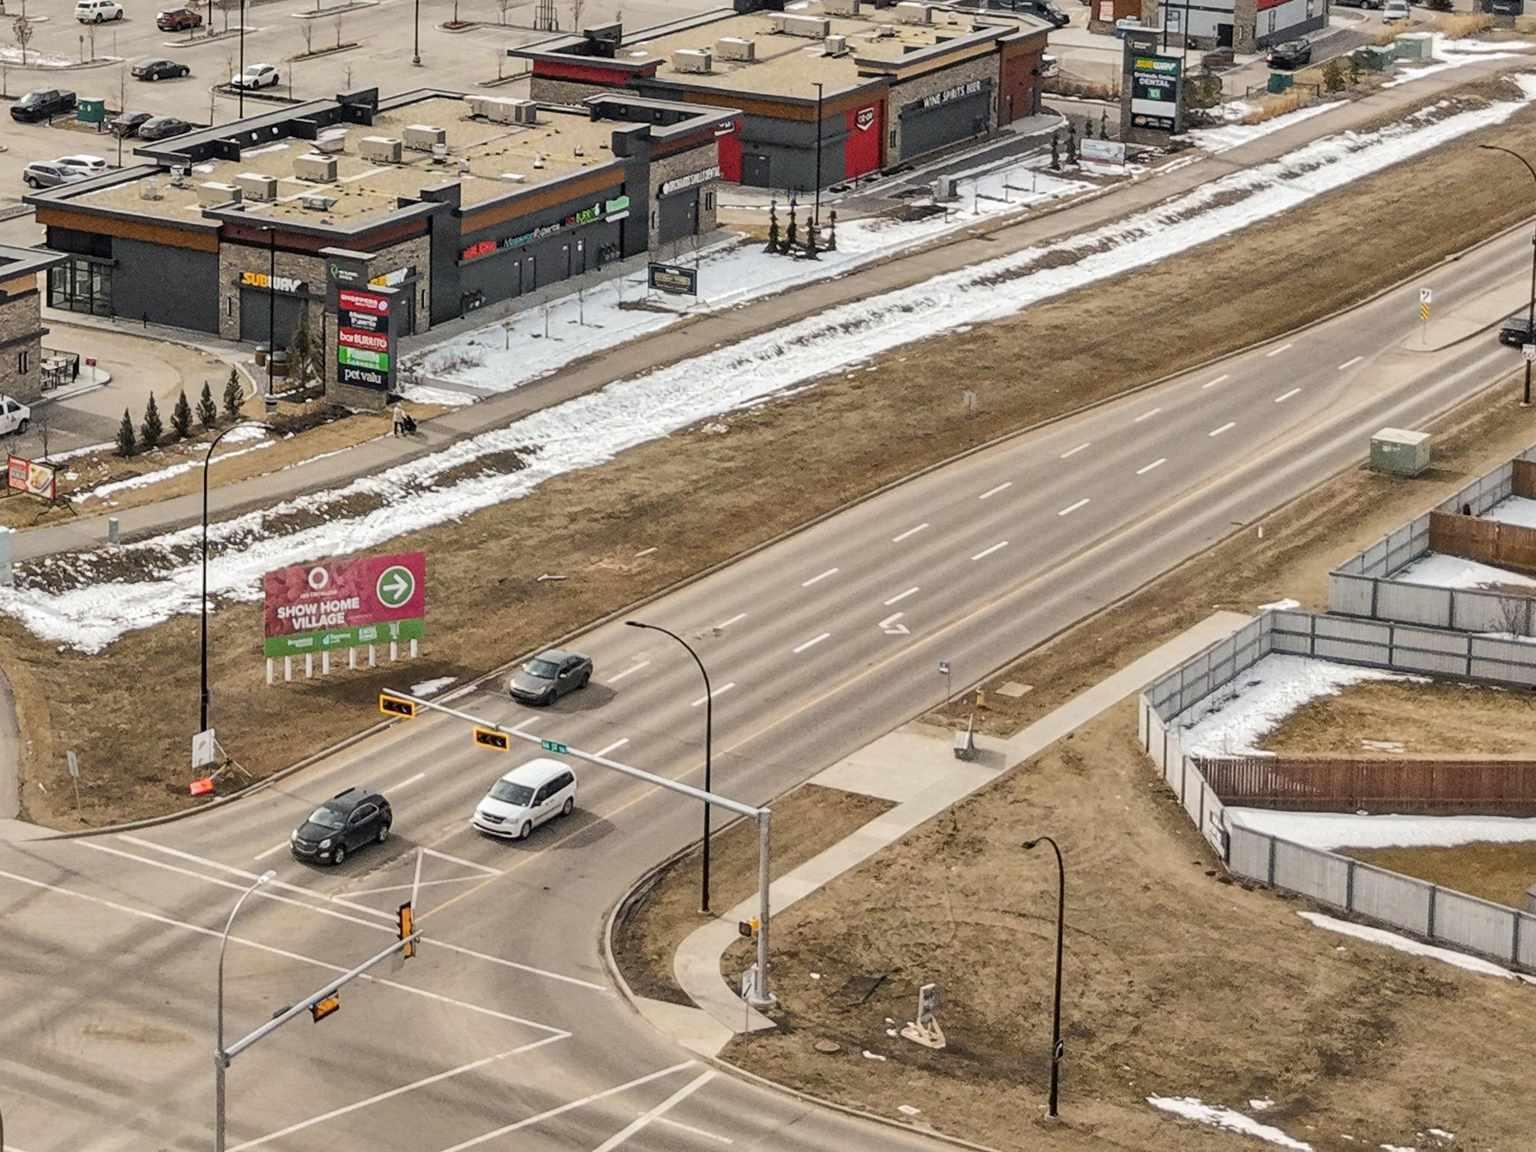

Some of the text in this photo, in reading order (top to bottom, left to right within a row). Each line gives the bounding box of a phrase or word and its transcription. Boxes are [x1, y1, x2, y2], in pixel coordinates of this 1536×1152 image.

[242, 272, 302, 293] SUBWAY
[344, 369, 382, 384] pet valu
[277, 596, 360, 619] SHOW HOME
[292, 612, 346, 630] VILLAGE
